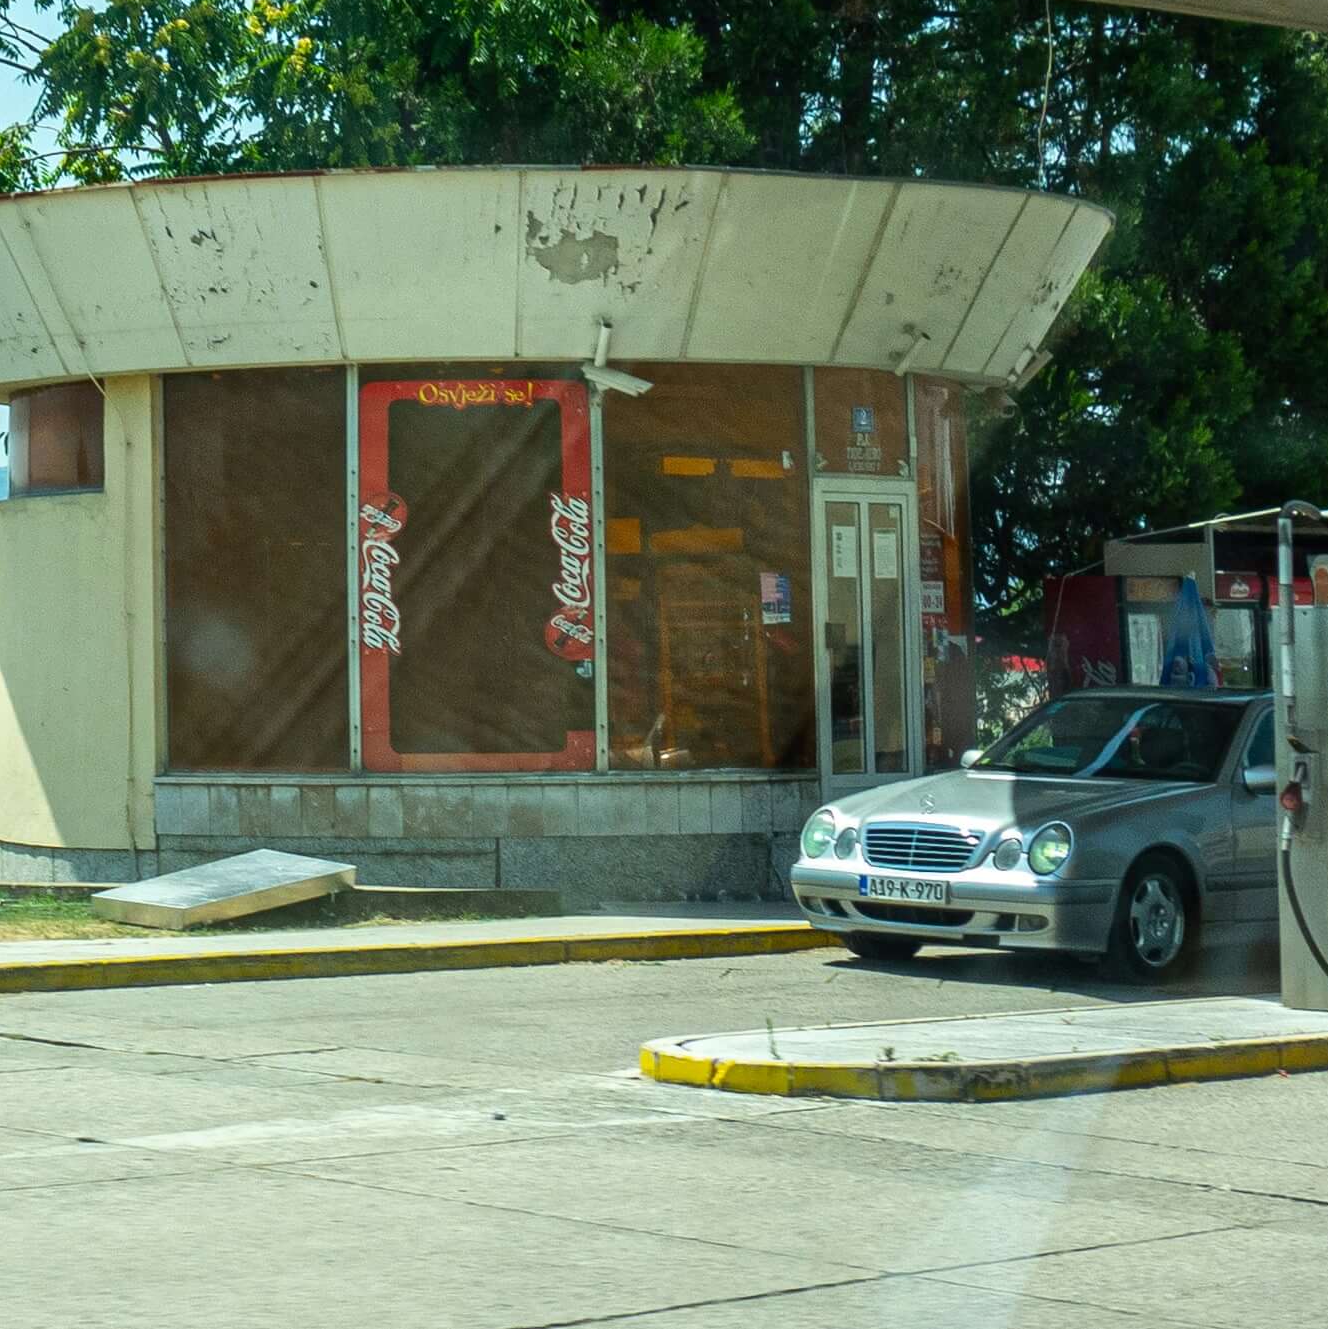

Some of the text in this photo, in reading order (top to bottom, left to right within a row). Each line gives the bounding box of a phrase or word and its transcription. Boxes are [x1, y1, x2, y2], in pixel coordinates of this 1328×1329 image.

[503, 381, 533, 407] se!
[550, 492, 591, 608] Coca-Cola
[362, 539, 402, 655] Coca-Cola
[870, 878, 944, 901] A19-K-970
